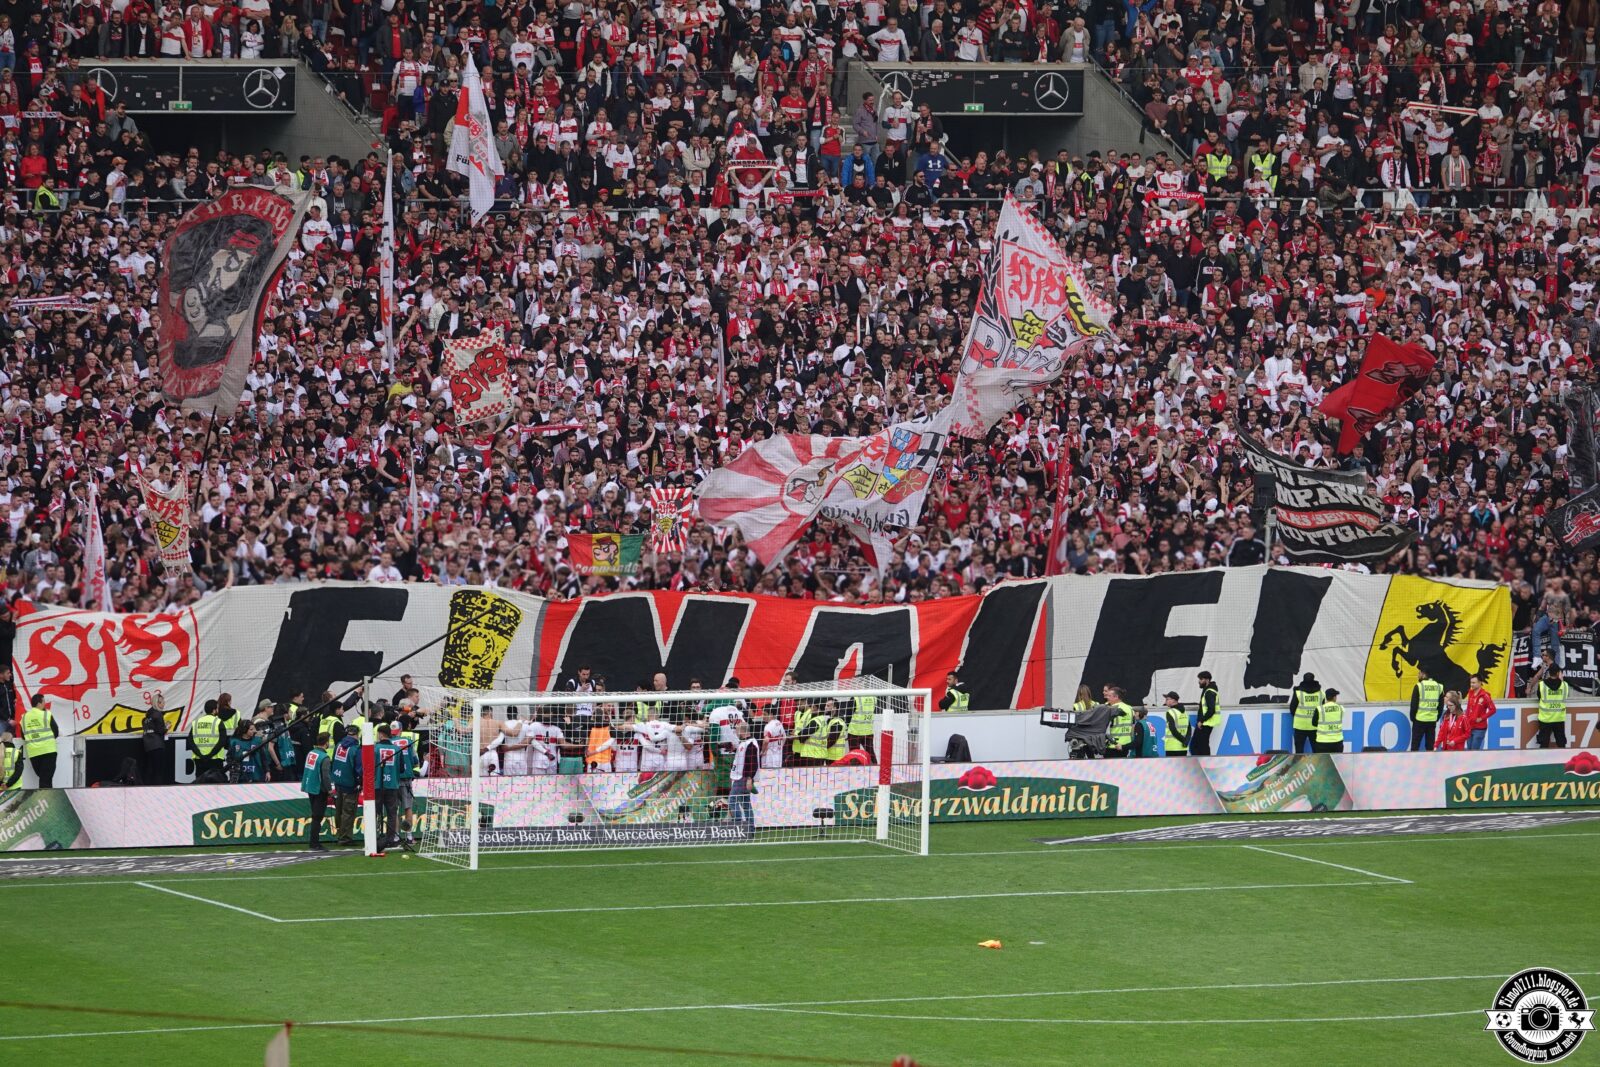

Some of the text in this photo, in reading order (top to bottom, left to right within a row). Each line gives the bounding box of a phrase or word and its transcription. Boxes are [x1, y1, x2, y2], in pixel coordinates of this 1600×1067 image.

[557, 828, 592, 842] Bank
[604, 825, 747, 841] Mercedes-Benz Bank
